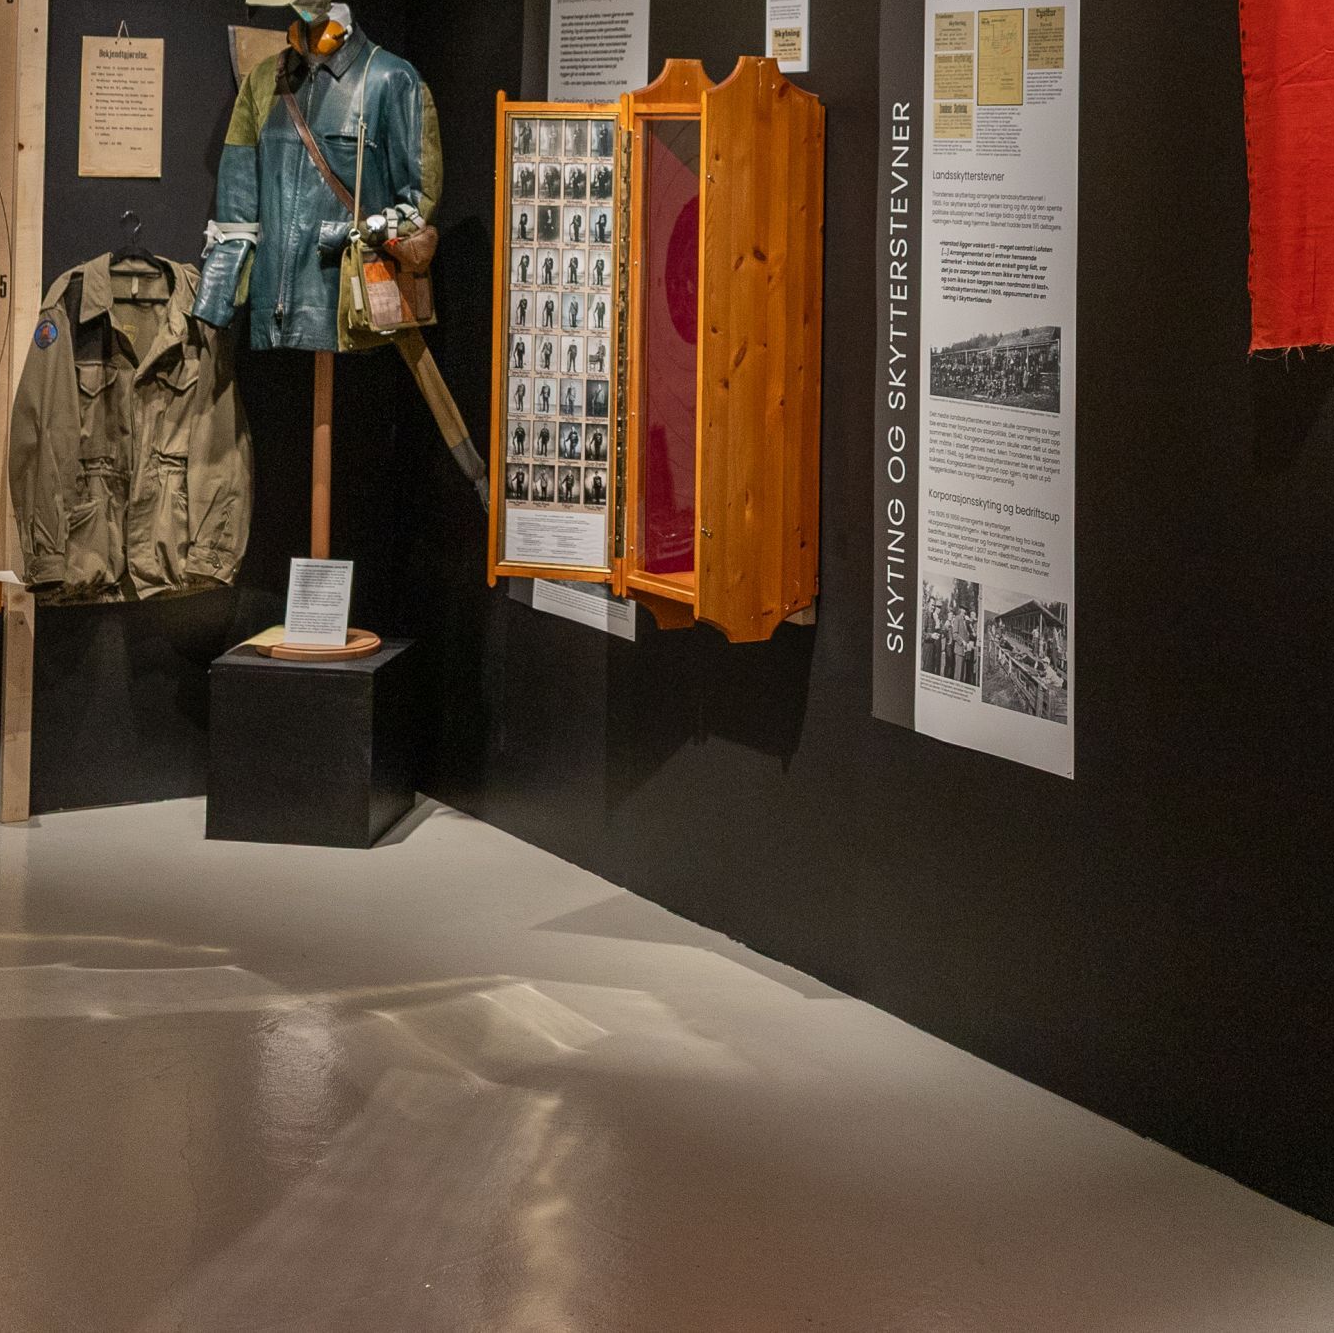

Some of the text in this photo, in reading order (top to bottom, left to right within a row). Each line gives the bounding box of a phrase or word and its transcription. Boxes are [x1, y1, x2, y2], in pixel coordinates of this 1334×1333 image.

[932, 170, 1004, 183] Landsskytterstevner
[0, 274, 8, 299] 5
[886, 101, 911, 654] SKYTING OG SKYTTERSTEVNER
[928, 488, 1059, 524] Korporasjonsskyting og bedriftscup
